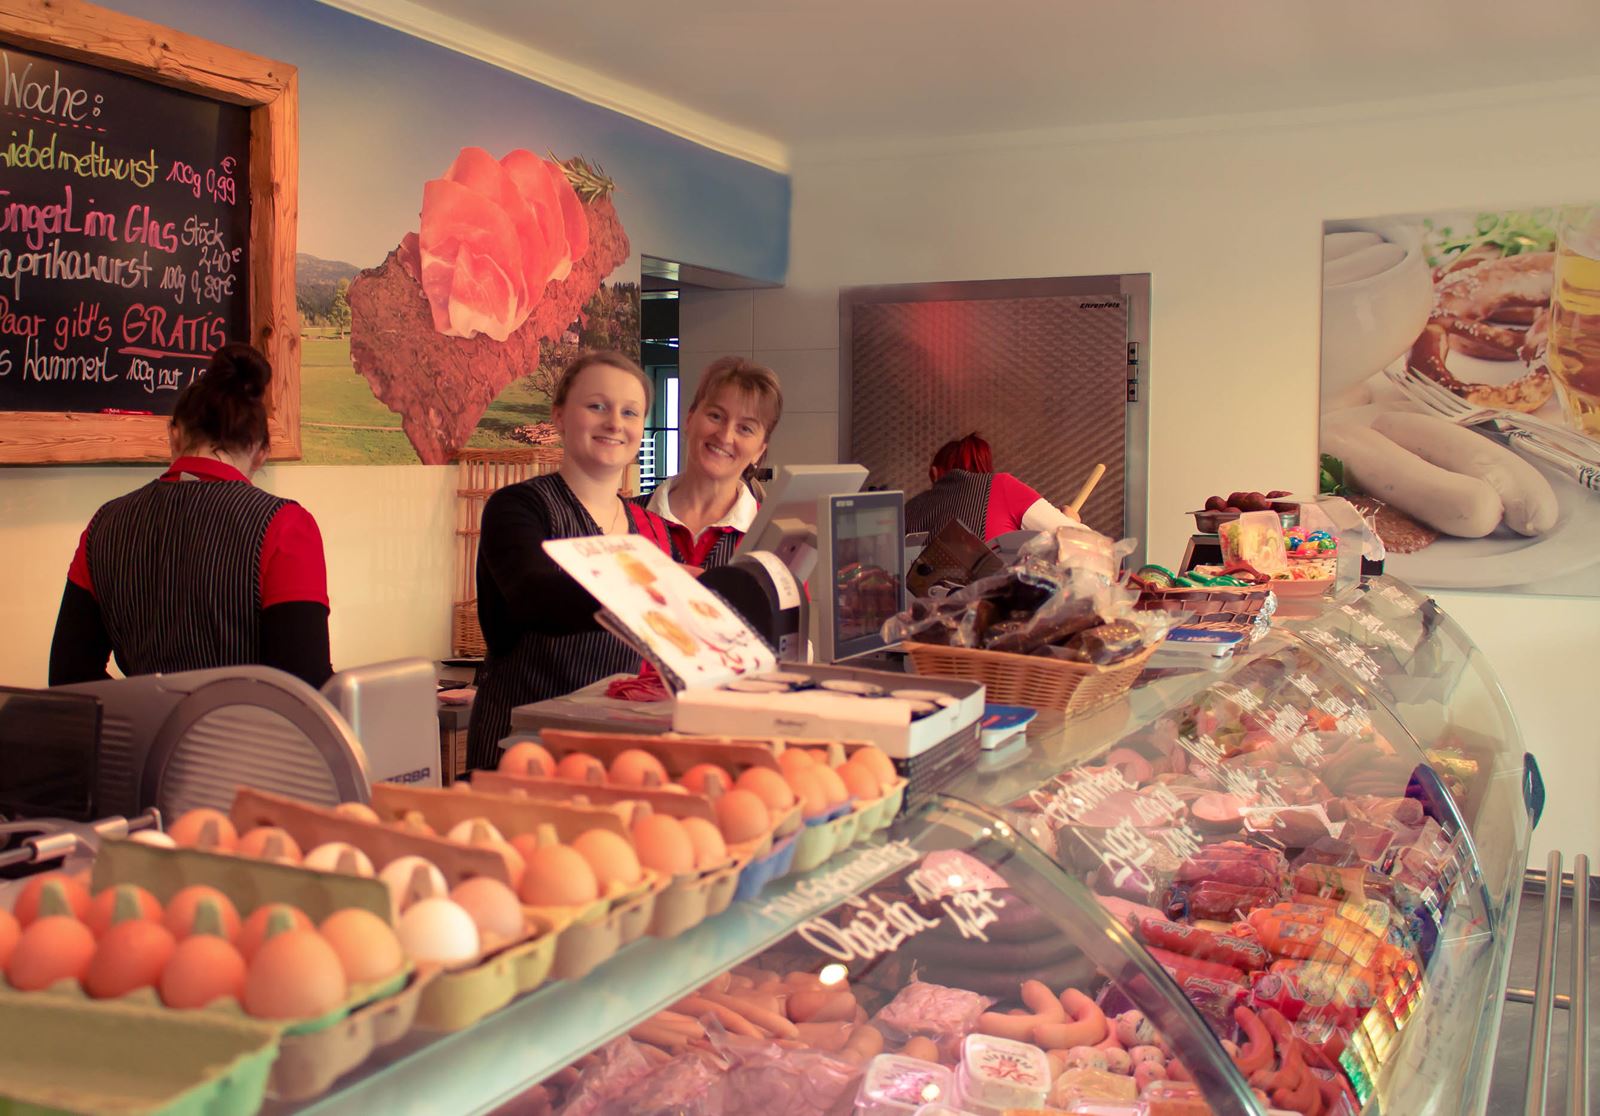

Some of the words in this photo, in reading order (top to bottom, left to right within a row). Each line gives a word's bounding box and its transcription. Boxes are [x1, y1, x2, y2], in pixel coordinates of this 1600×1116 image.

[2, 53, 104, 122] Woche:
[84, 199, 118, 242] im
[124, 204, 178, 254] Glas
